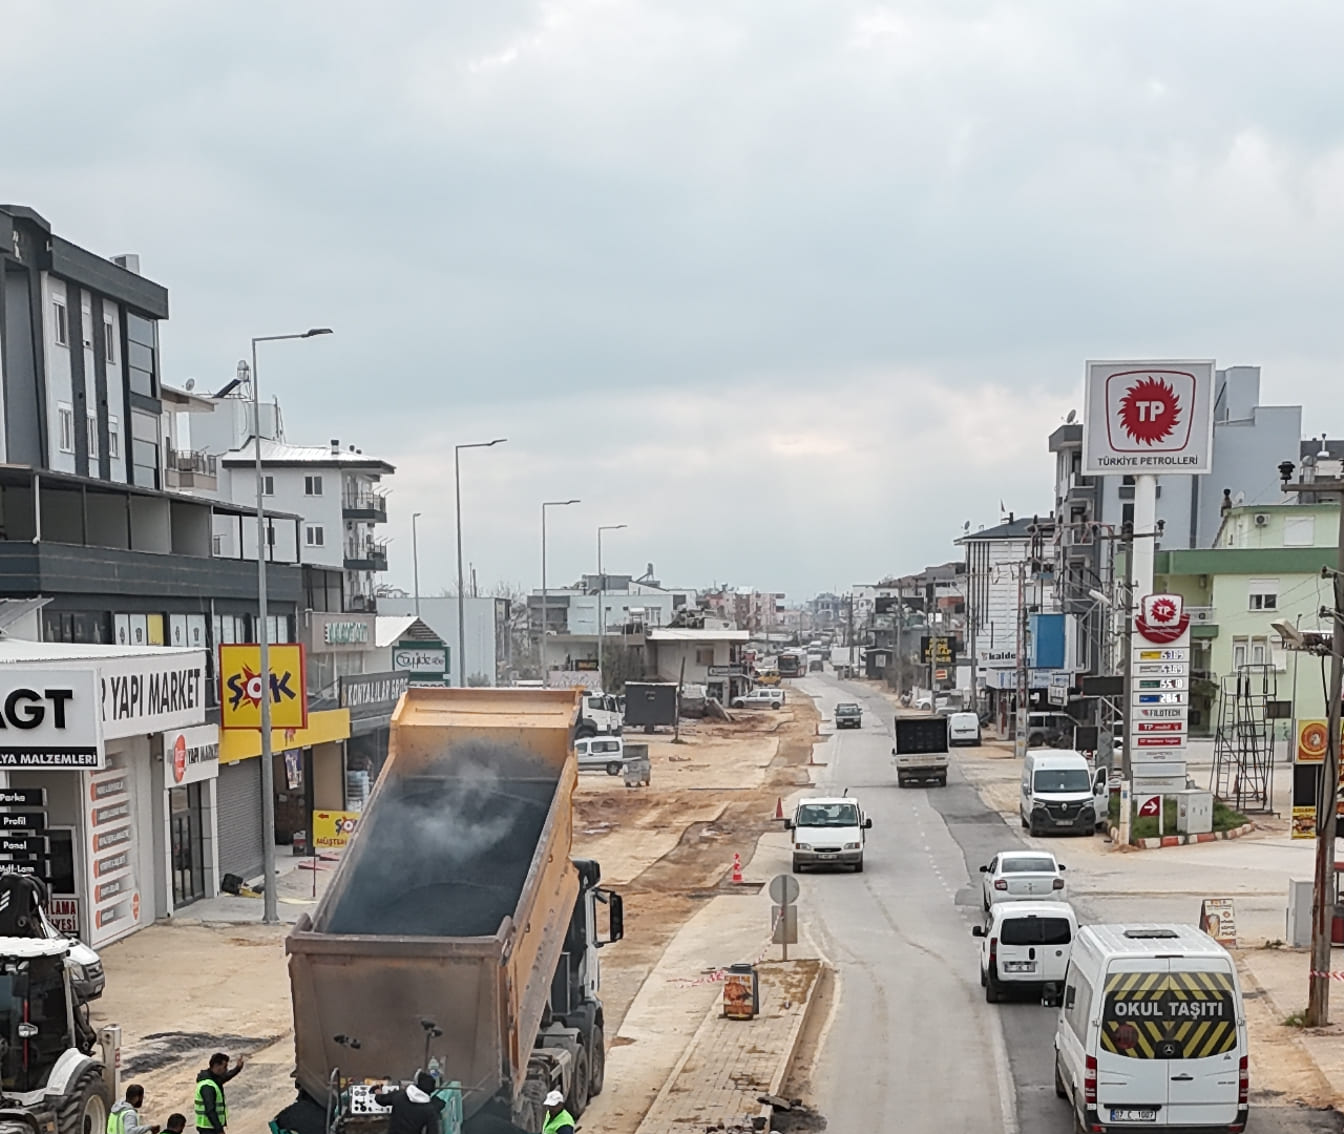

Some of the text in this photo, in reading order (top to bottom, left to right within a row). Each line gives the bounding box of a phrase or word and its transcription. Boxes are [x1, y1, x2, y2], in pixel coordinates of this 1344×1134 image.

[1136, 401, 1165, 422] TP
[1097, 455, 1198, 466] TÜRKİYE PETROLLERİ
[110, 674, 143, 720] YAPI
[148, 668, 201, 715] MARKET
[227, 664, 297, 712] ŞOK
[20, 751, 97, 765] MALZEMLERİ
[0, 793, 26, 802] Parke
[3, 817, 26, 826] Profil
[3, 840, 27, 849] Panel
[1114, 1002, 1223, 1019] OKUL TAŞITI
